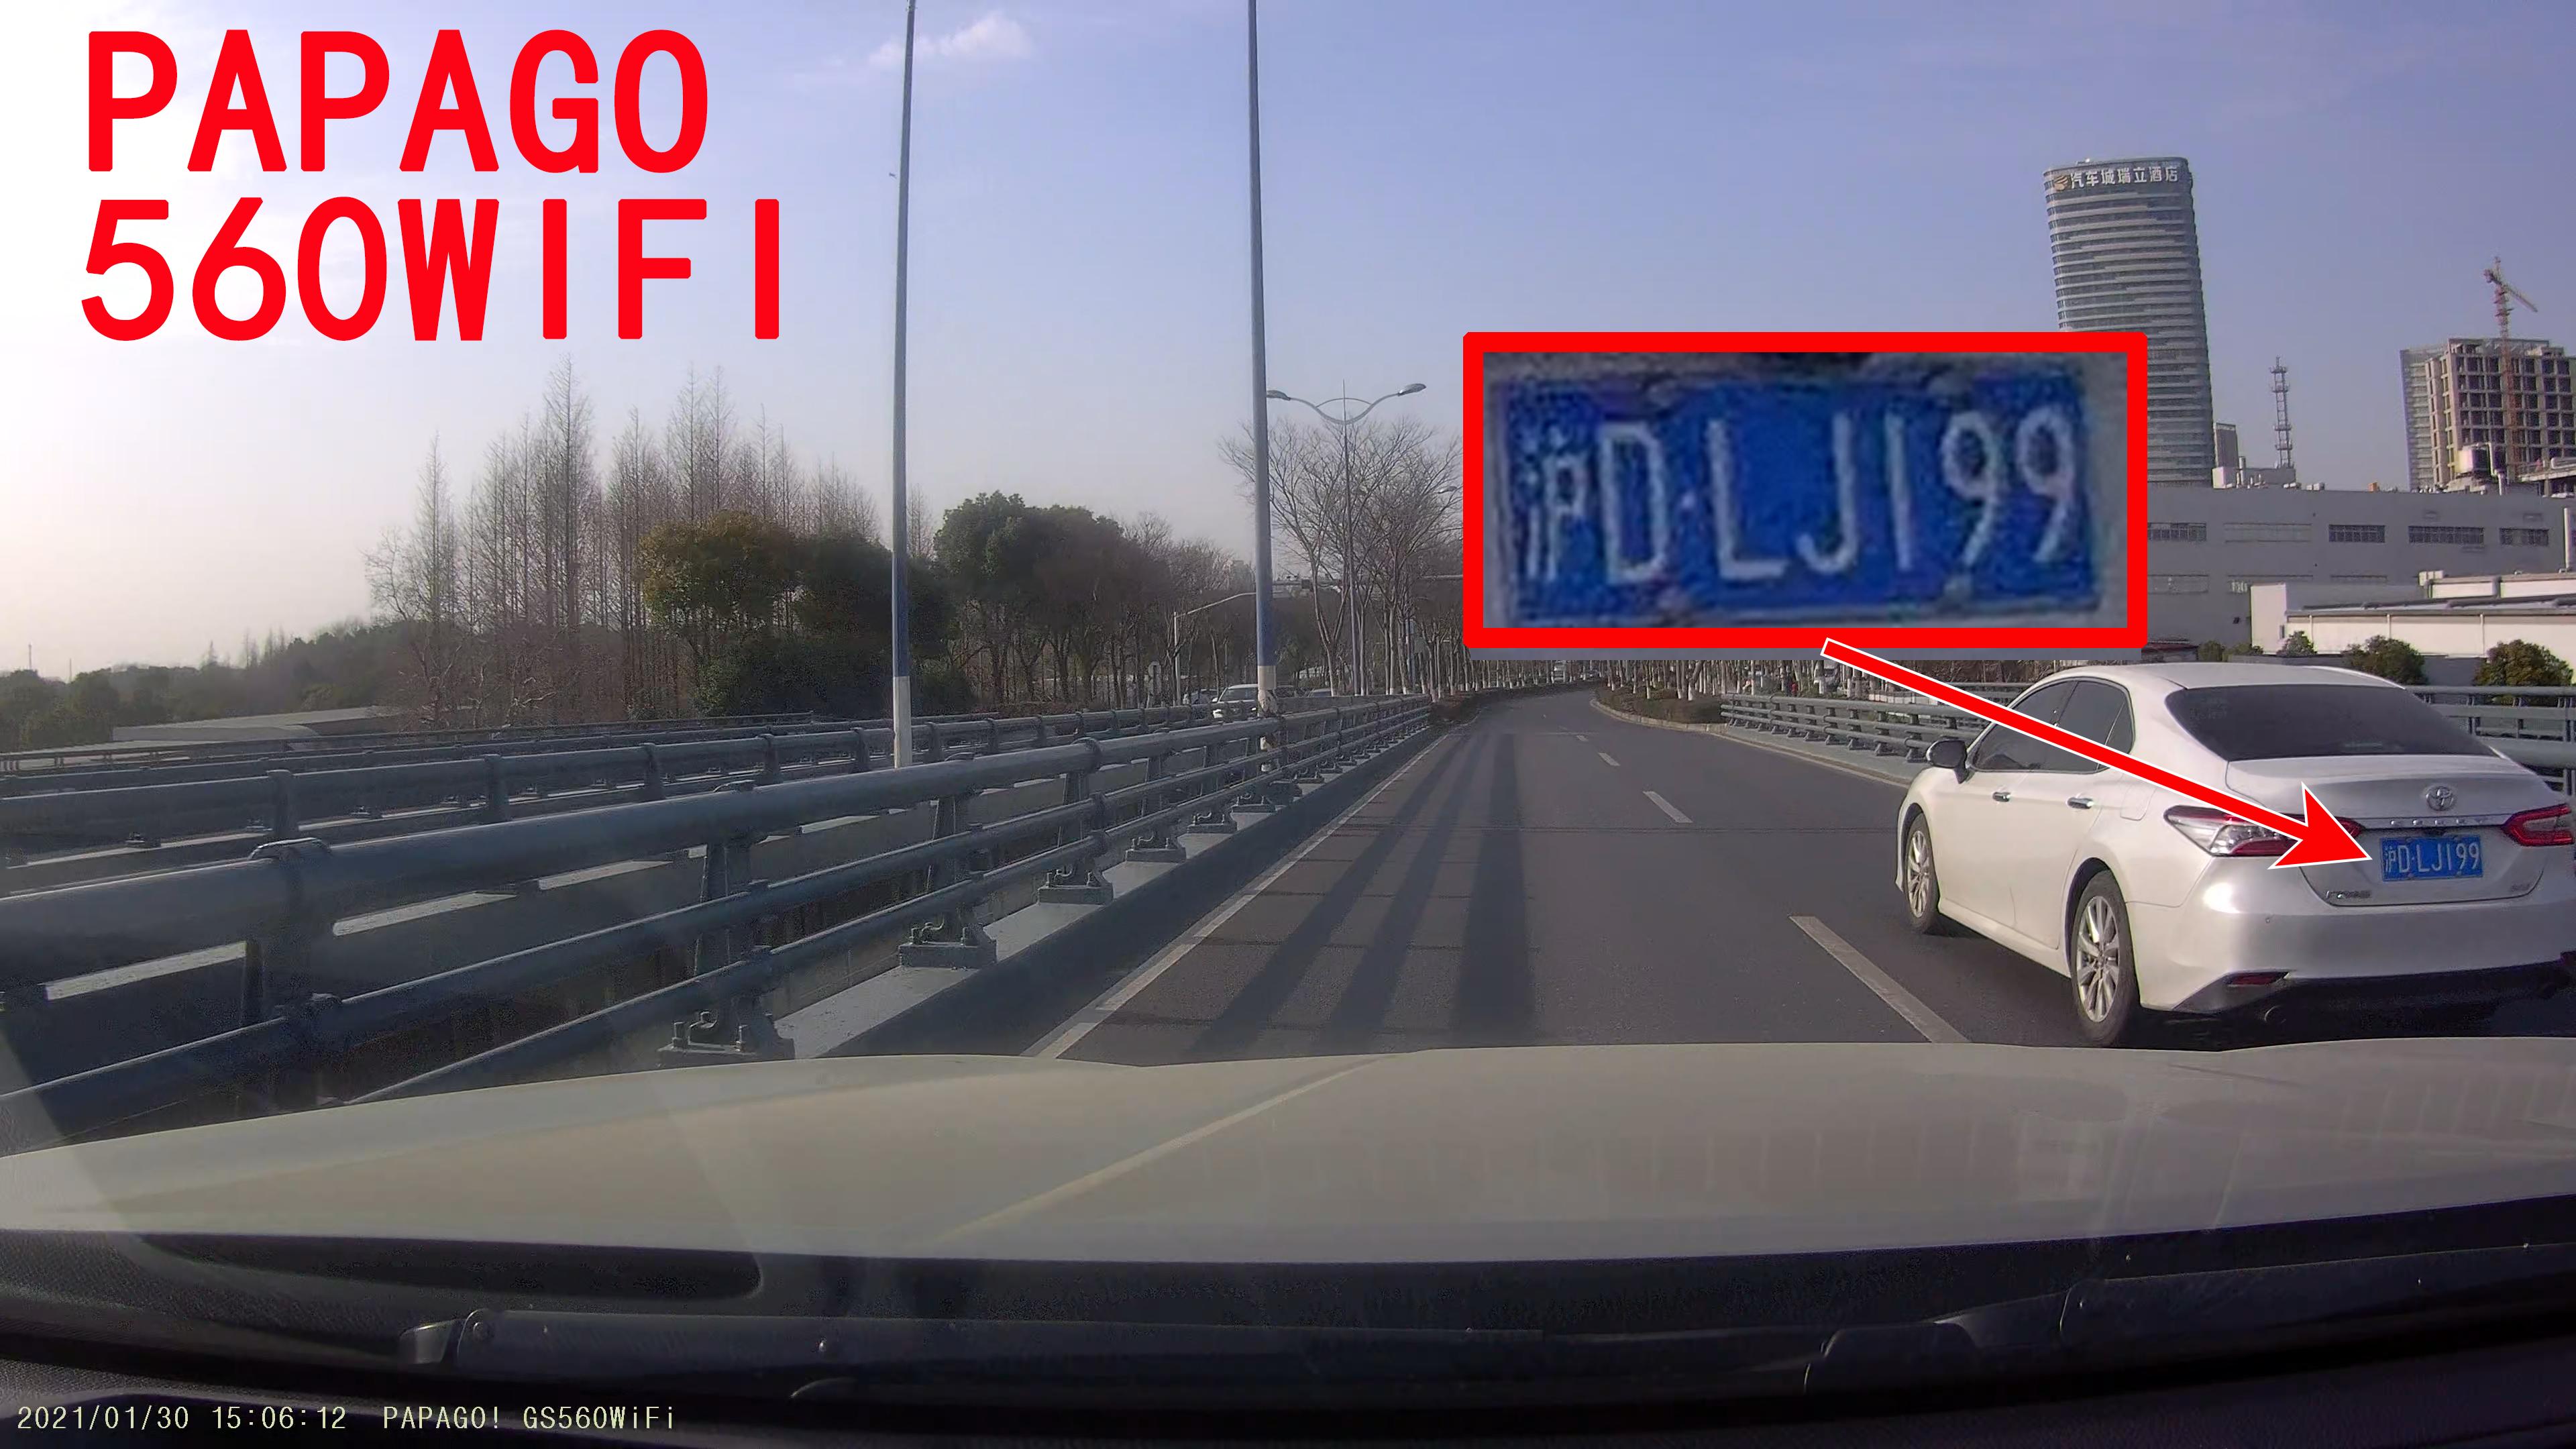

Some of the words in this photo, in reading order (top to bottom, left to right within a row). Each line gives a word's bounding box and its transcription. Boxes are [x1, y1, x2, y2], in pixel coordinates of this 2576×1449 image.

[2070, 166, 2179, 189] 汽车城瑞立酒店
